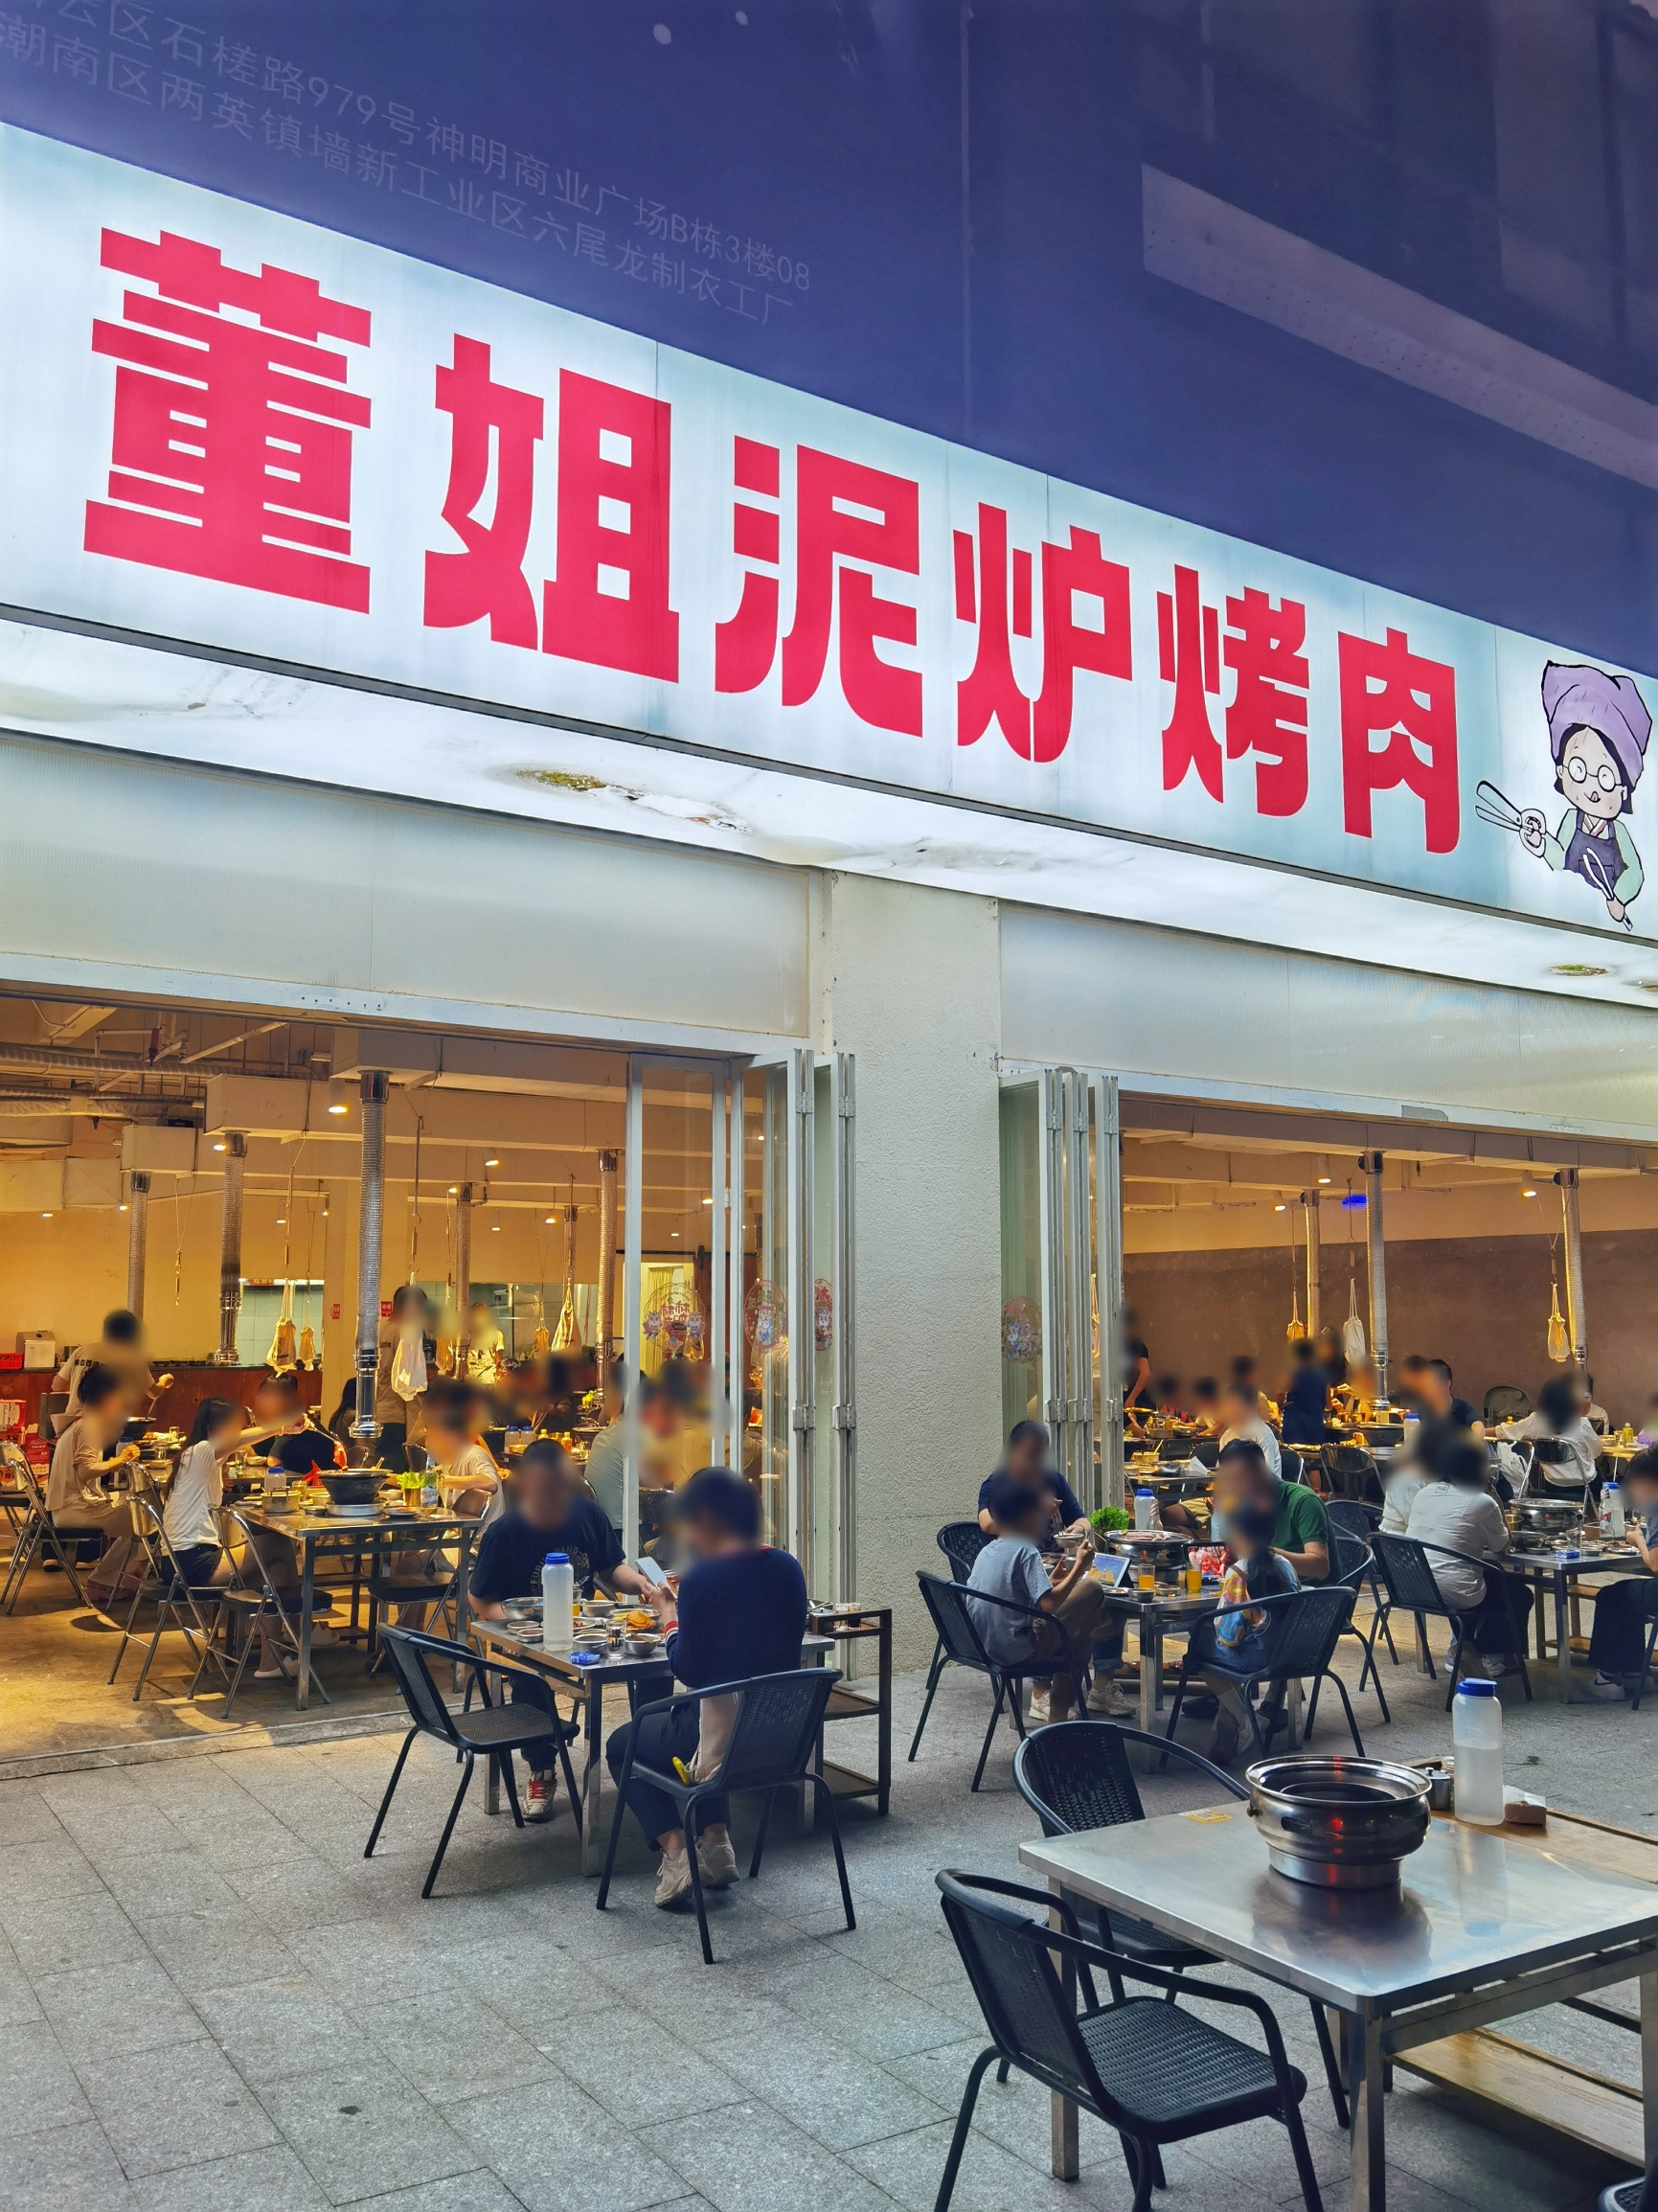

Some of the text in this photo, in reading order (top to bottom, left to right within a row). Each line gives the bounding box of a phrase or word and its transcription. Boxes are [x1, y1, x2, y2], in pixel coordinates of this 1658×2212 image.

[34, 0, 810, 291] 云区石槎路979号神明商业广场B栋3楼08
[83, 227, 1461, 854] 董姐泥炉烤肉
